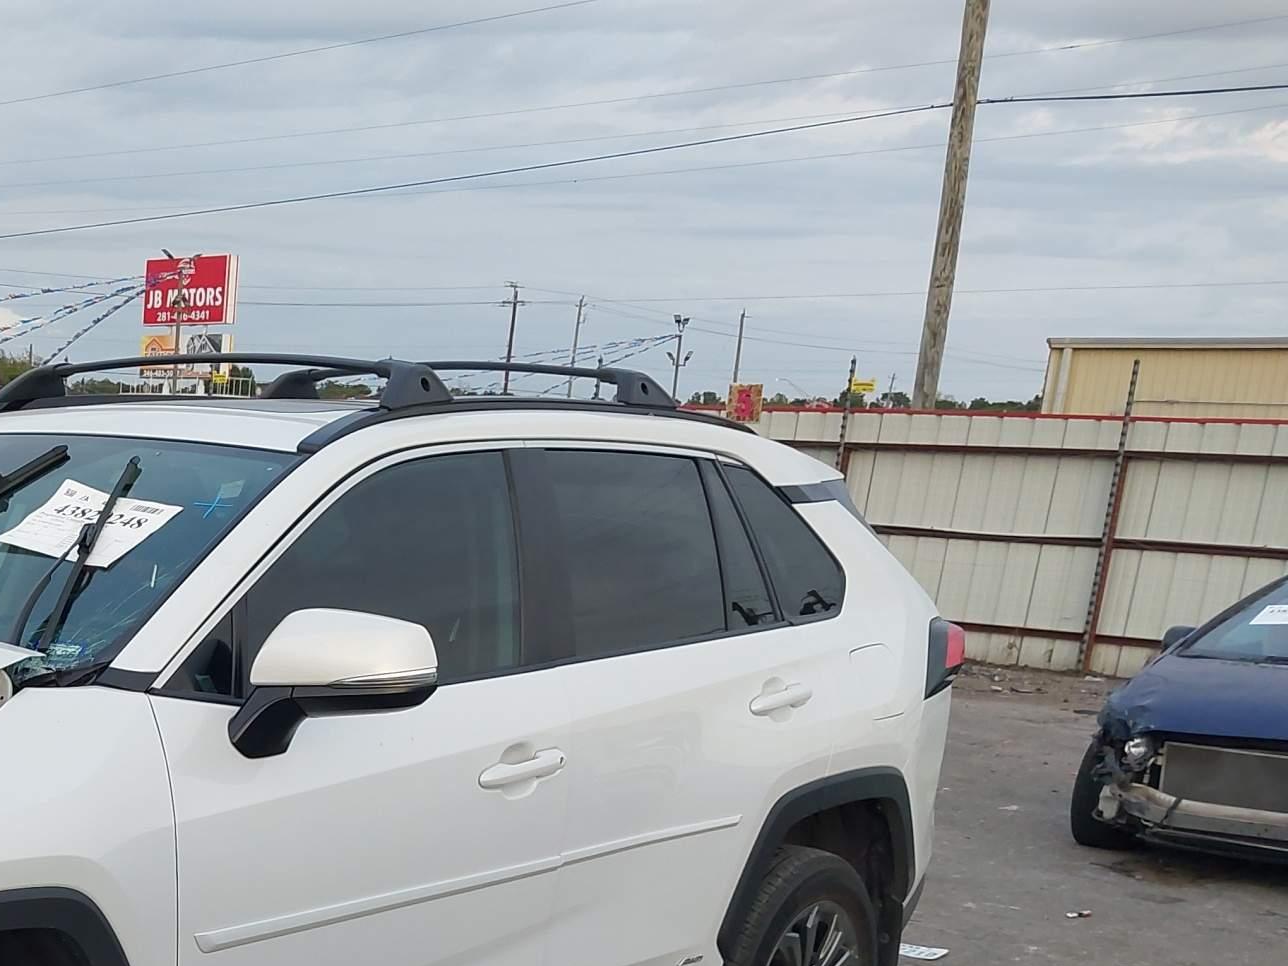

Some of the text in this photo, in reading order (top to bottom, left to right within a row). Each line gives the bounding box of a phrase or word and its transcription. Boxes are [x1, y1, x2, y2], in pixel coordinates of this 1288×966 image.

[147, 290, 163, 309] JB
[156, 310, 210, 322] 281-46-4341
[53, 503, 149, 530] 4382248
